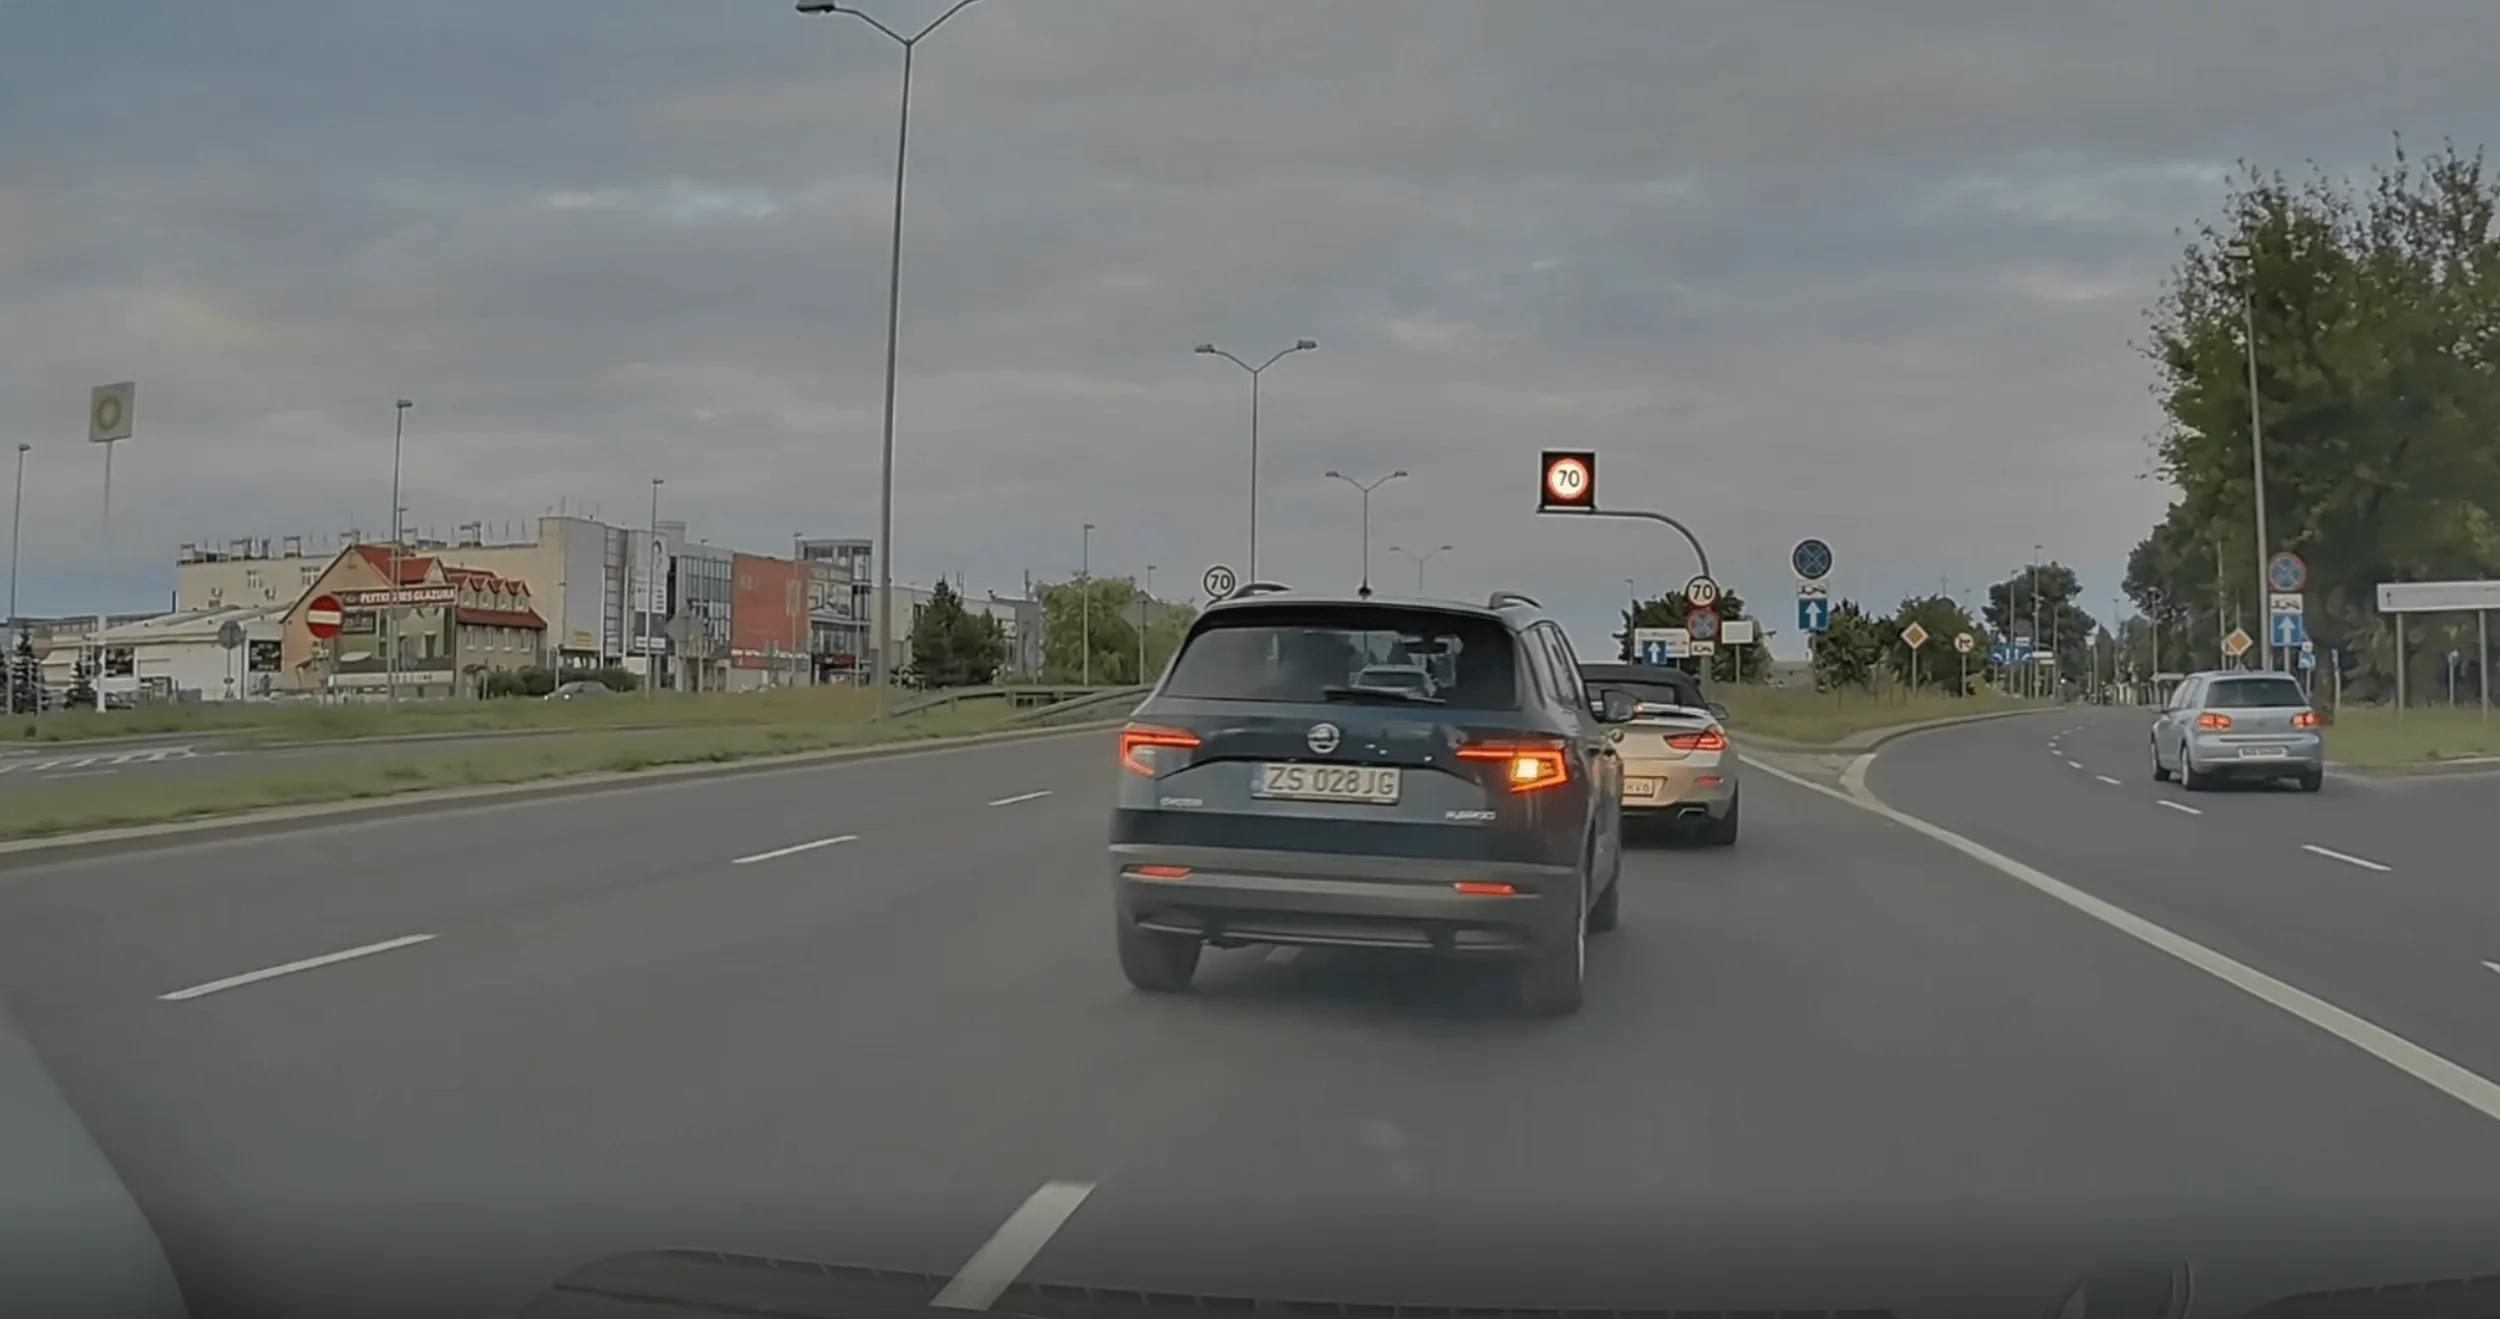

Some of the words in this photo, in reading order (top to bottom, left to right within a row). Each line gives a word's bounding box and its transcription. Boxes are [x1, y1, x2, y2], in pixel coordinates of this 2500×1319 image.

[1558, 469, 1581, 488] 70
[1210, 574, 1231, 590] 70
[1691, 583, 1714, 600] 70
[1267, 766, 1307, 791] ZS
[1312, 768, 1397, 795] 028JG
